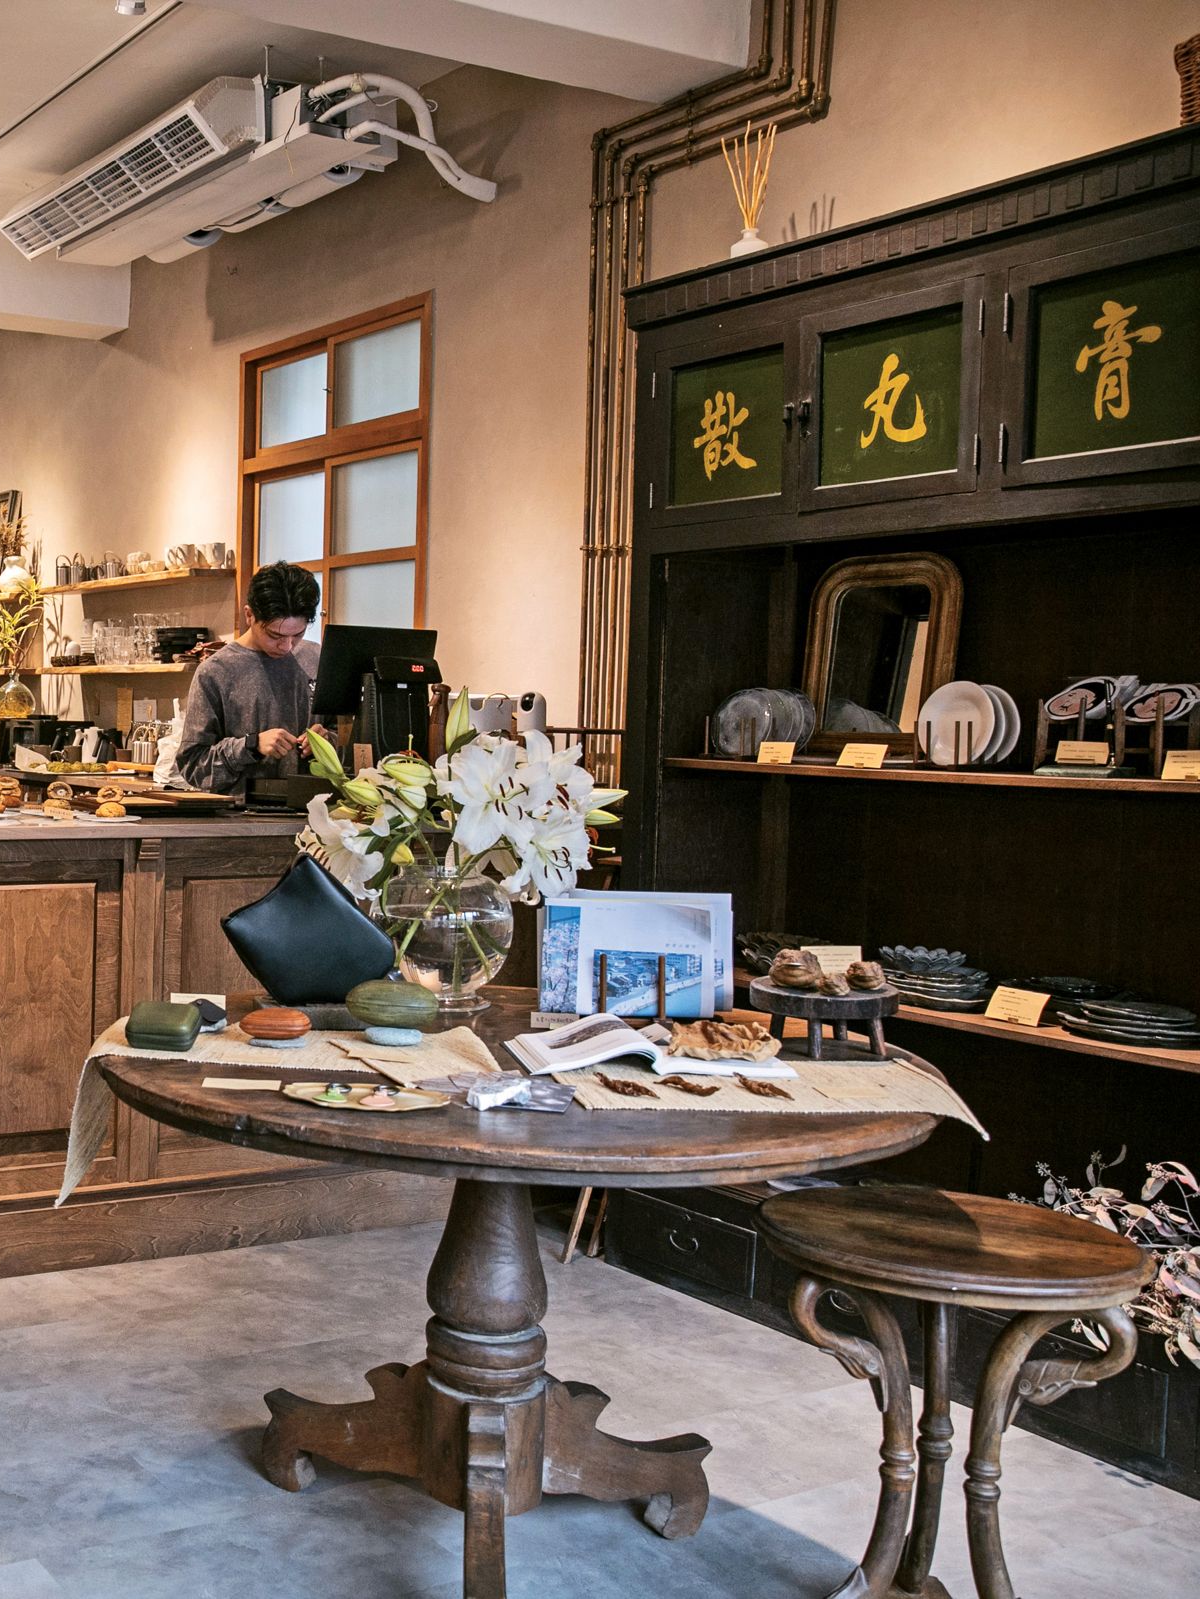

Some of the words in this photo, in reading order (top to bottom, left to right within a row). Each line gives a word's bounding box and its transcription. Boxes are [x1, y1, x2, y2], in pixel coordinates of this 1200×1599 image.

[860, 352, 928, 450] 丸
[1075, 300, 1161, 420] 膏
[693, 390, 757, 481] 散
